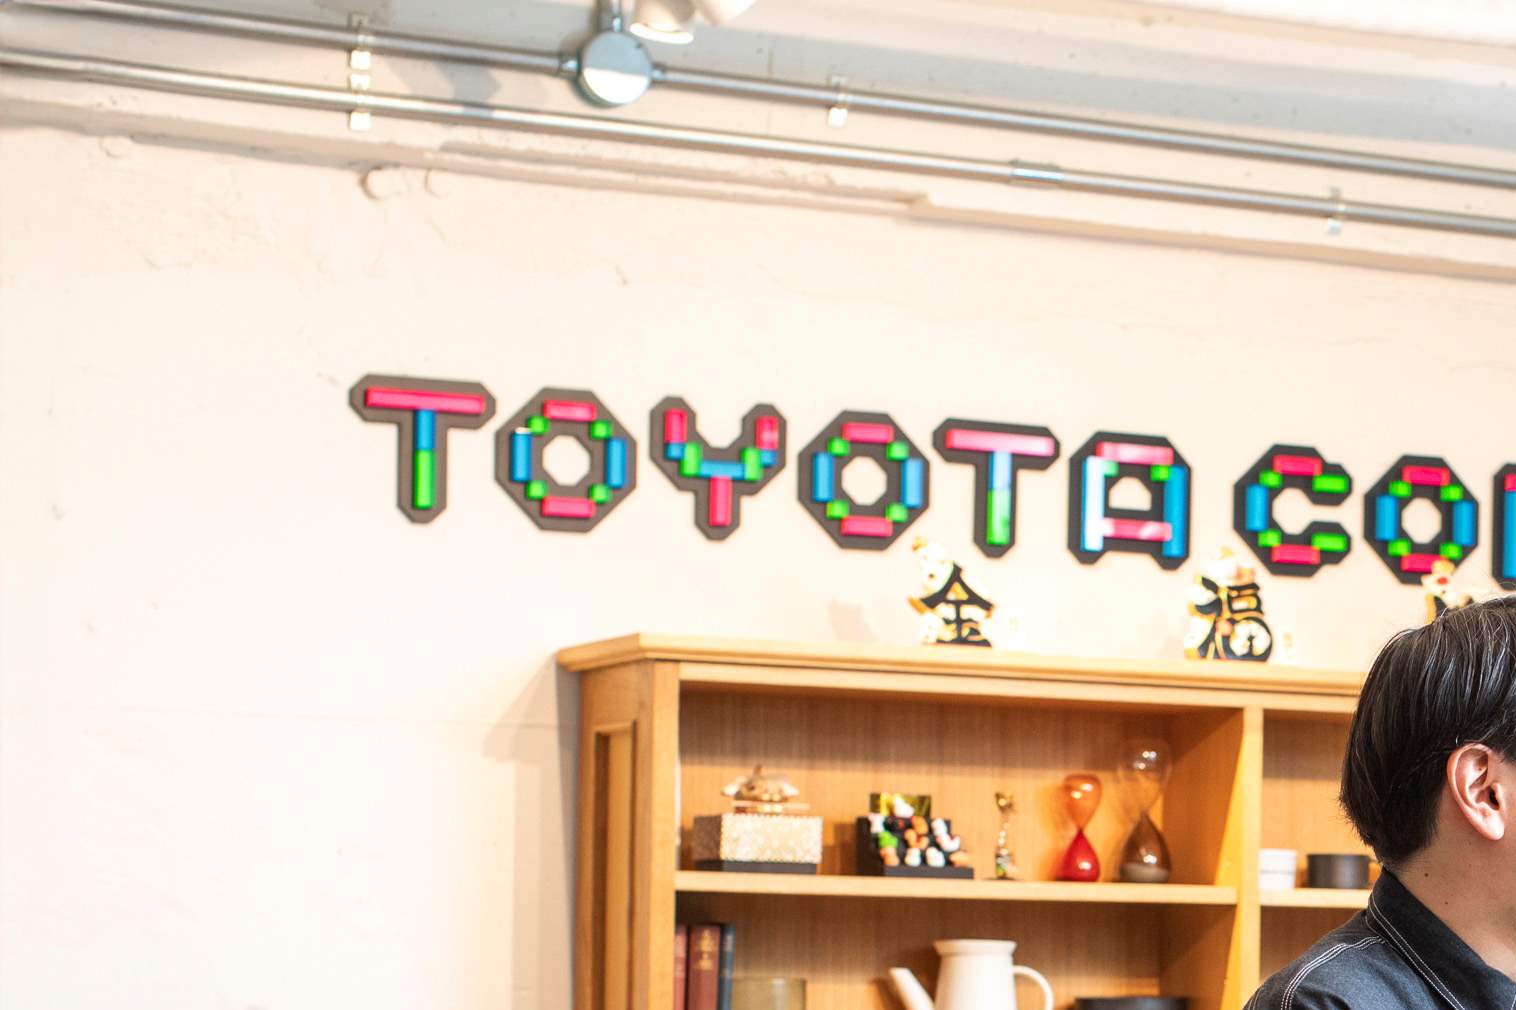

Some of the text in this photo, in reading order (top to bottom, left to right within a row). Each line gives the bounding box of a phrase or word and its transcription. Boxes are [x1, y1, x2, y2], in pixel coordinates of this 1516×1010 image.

[349, 374, 1191, 570] TOYOTA
[919, 561, 994, 647] 金
[1194, 576, 1273, 661] 福
